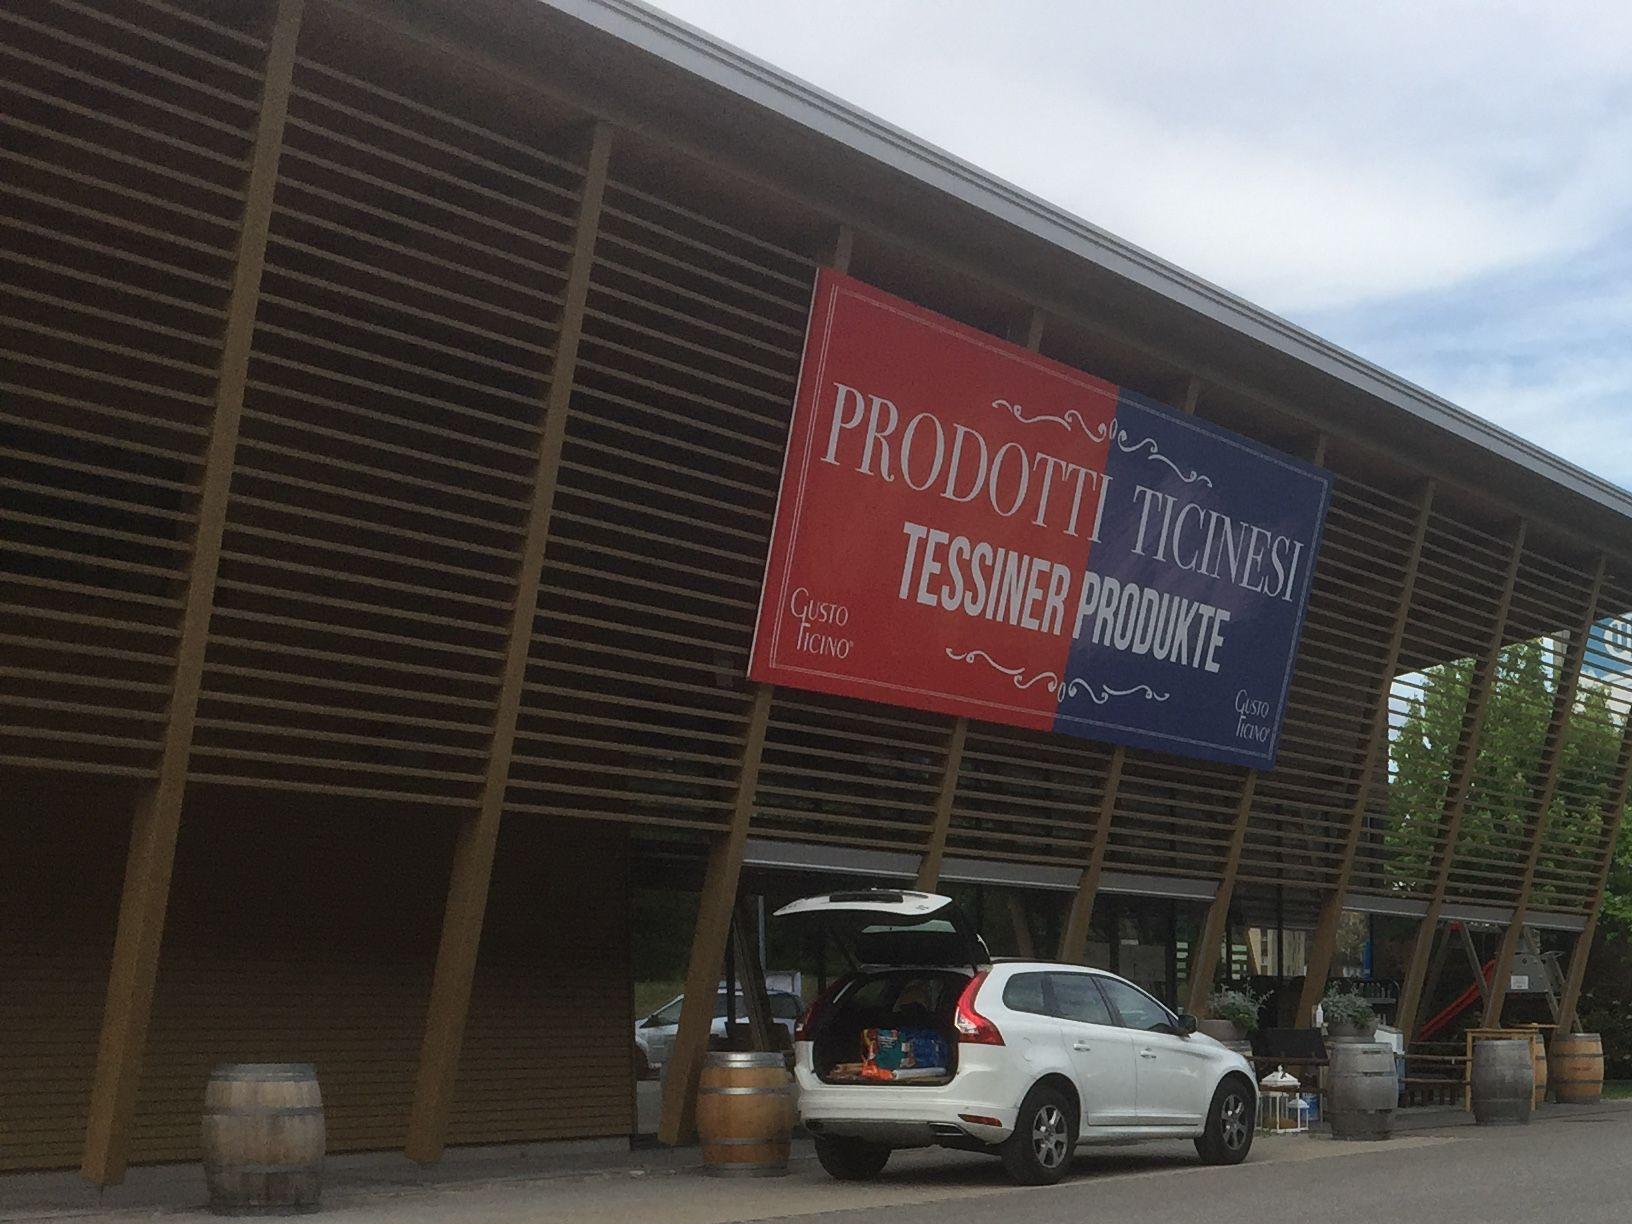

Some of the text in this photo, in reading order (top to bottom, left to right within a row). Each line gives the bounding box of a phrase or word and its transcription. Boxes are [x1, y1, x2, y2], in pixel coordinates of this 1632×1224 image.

[820, 382, 1305, 602] PRODOTTI TICINESI
[791, 587, 849, 627] GUSTO
[897, 522, 1231, 673] TESSINER PRODUKTE
